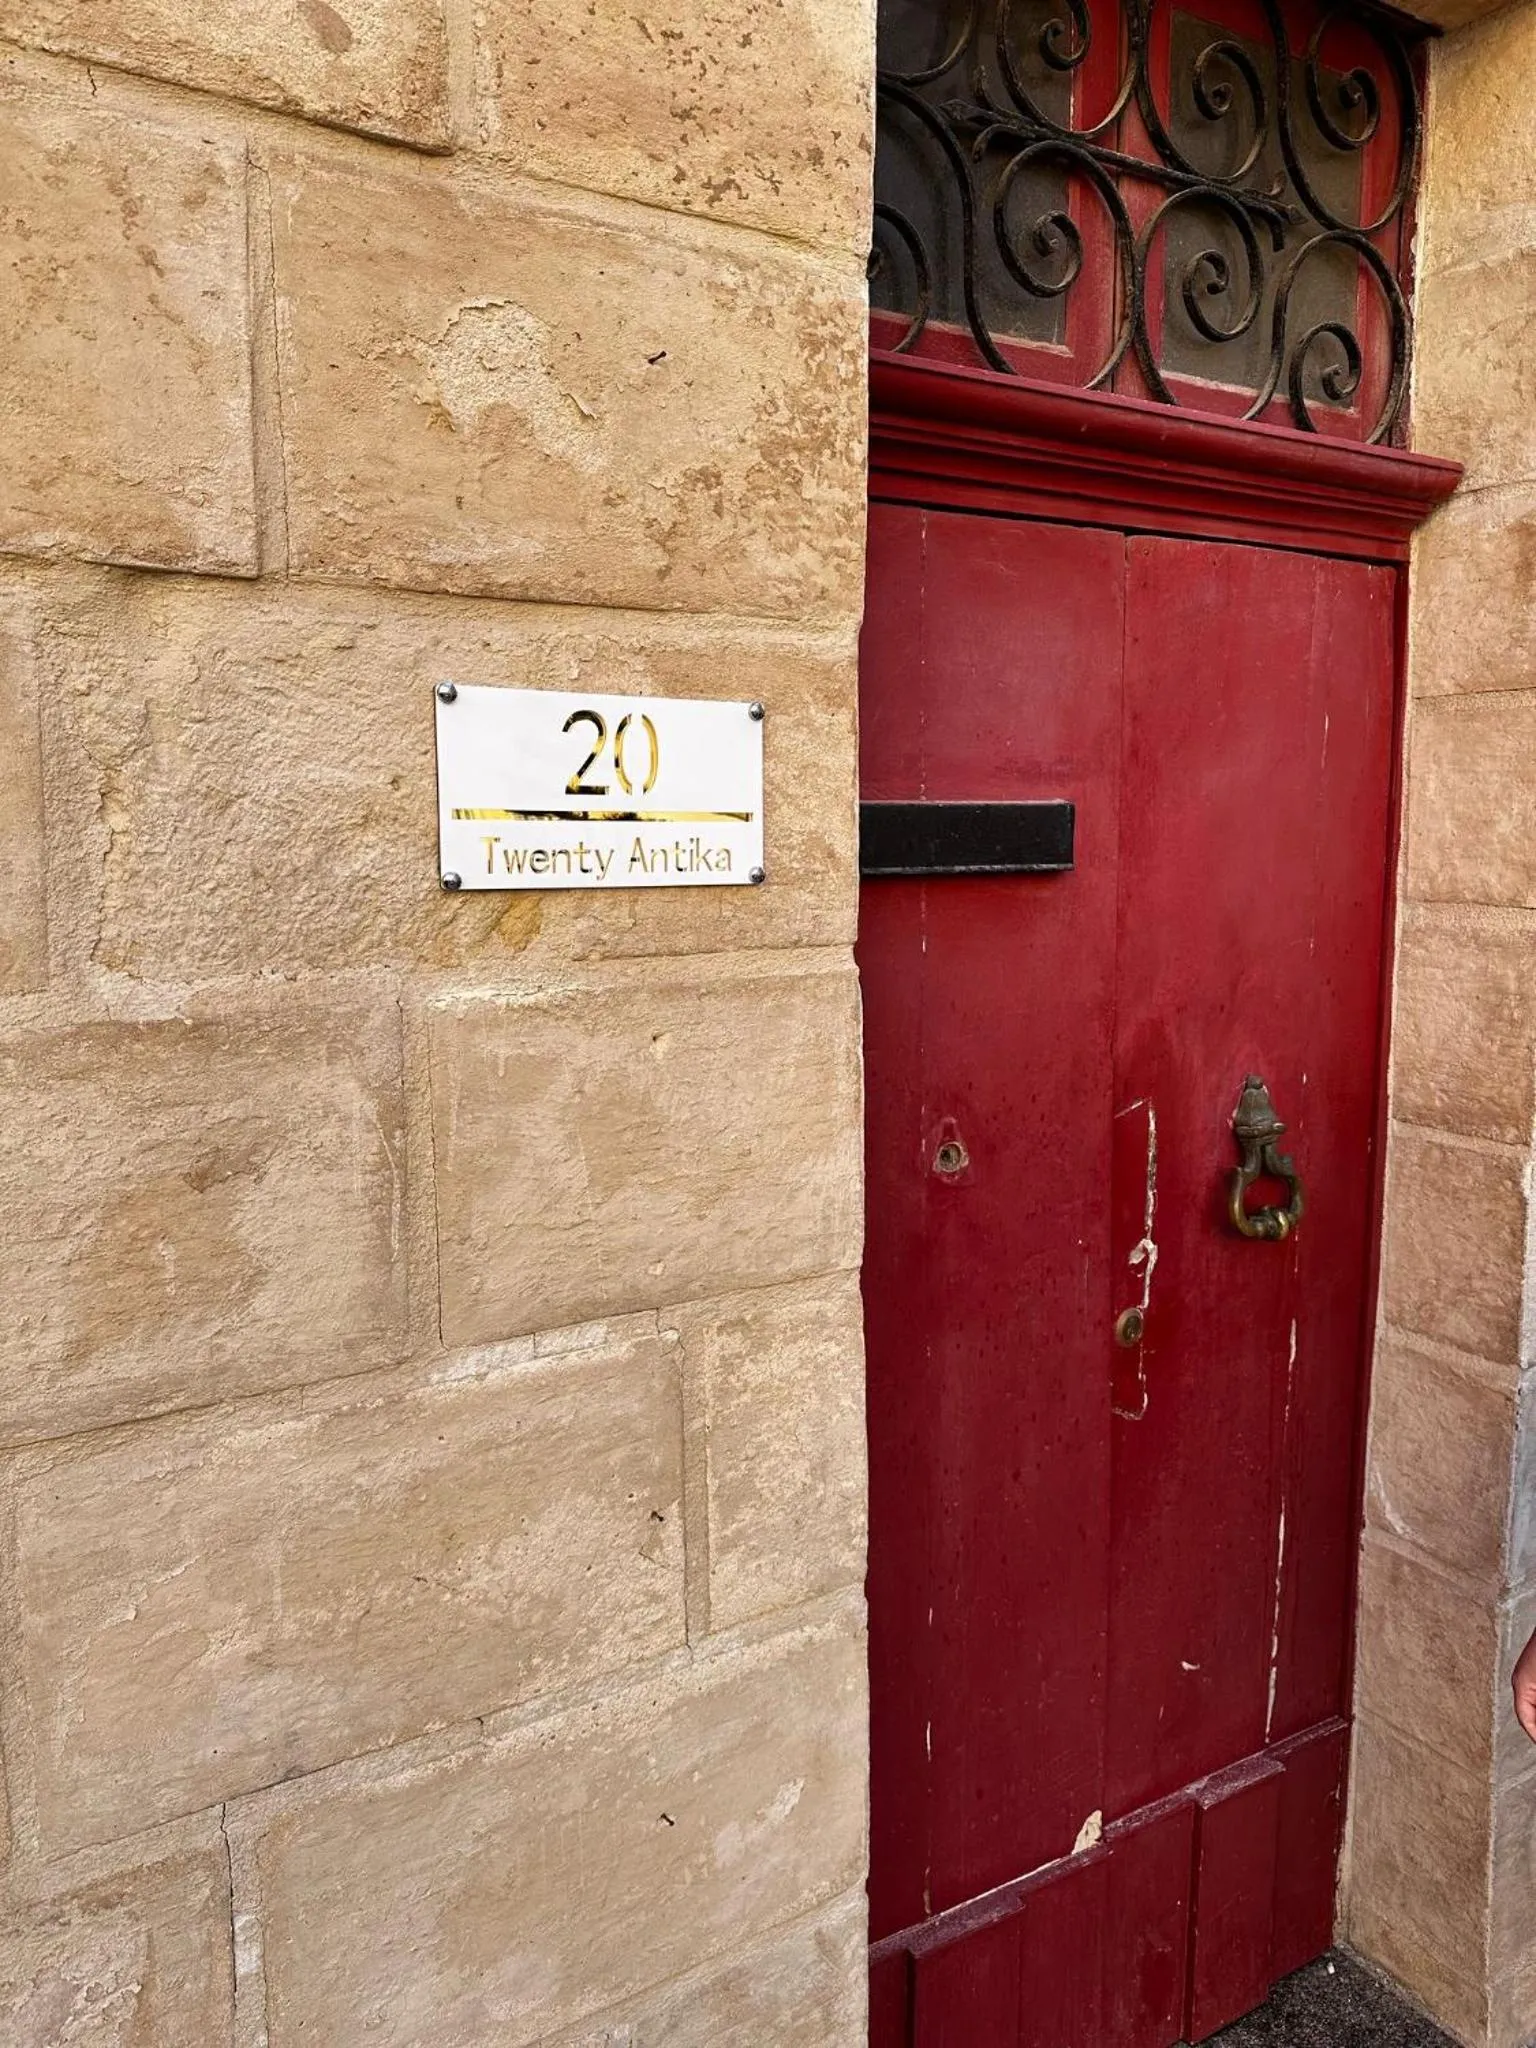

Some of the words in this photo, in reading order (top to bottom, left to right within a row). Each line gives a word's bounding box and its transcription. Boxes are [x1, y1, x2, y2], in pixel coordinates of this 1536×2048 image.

[562, 709, 659, 796] 20
[479, 836, 615, 881] Twenty
[628, 836, 733, 874] Antika
